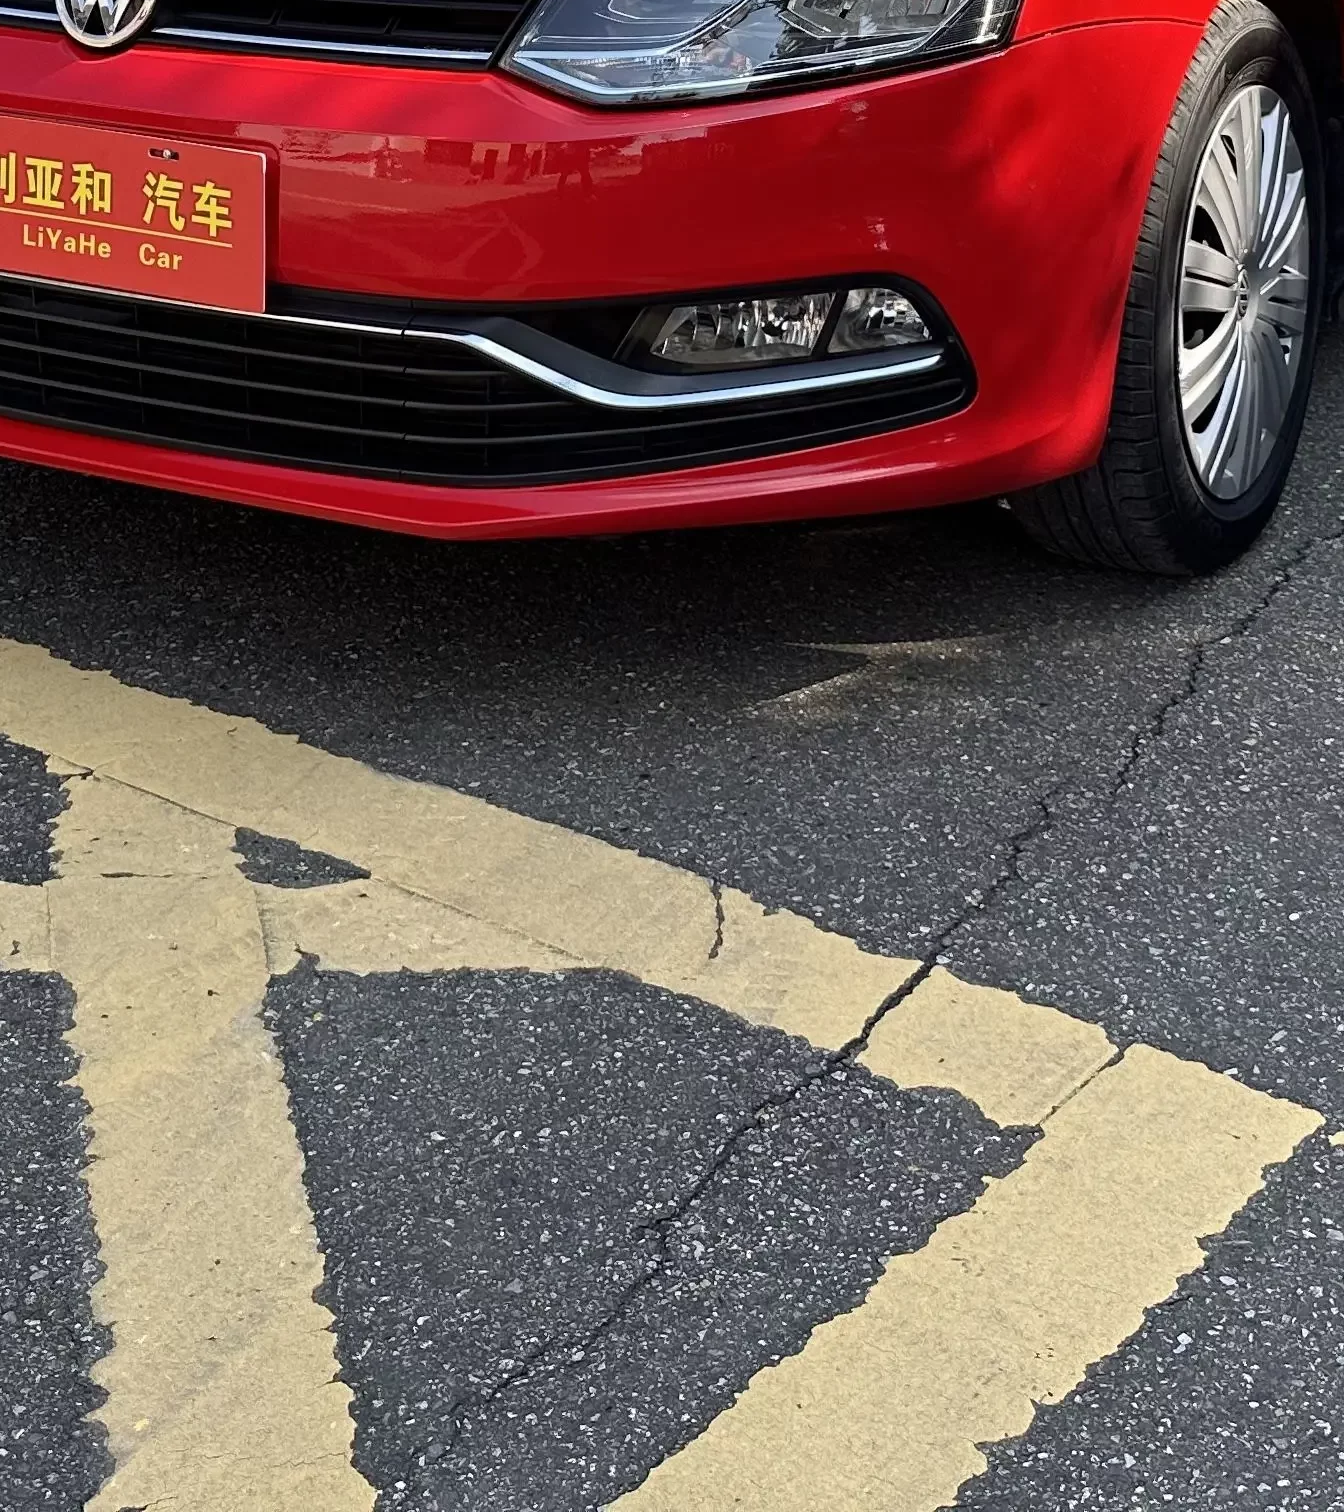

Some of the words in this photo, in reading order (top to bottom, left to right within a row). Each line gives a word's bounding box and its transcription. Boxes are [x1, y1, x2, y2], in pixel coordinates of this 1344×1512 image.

[142, 171, 233, 238] 汽车
[22, 223, 112, 259] LiYaHe
[138, 243, 183, 272] Car
